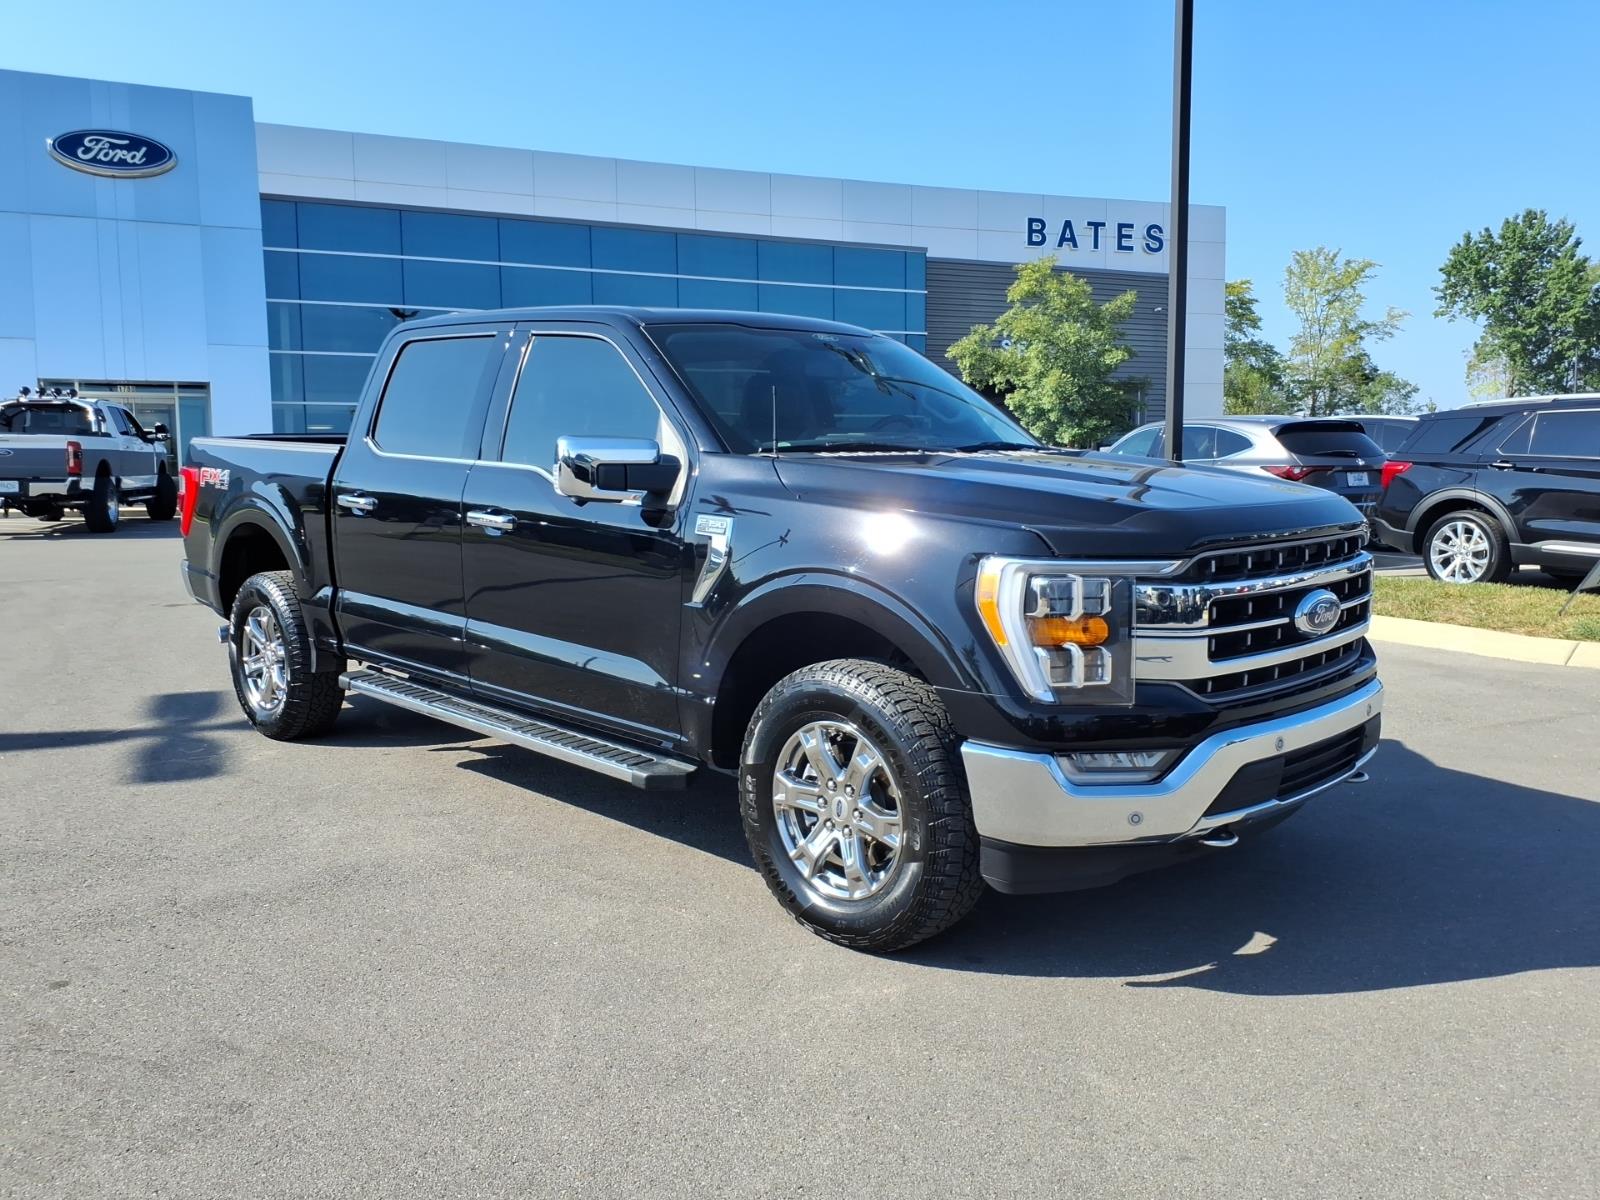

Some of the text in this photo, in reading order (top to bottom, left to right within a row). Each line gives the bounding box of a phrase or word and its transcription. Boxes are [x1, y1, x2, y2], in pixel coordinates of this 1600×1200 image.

[77, 135, 147, 164] Ford
[1027, 217, 1164, 253] BATES
[200, 467, 230, 487] FX4
[1315, 603, 1336, 624] Ford
